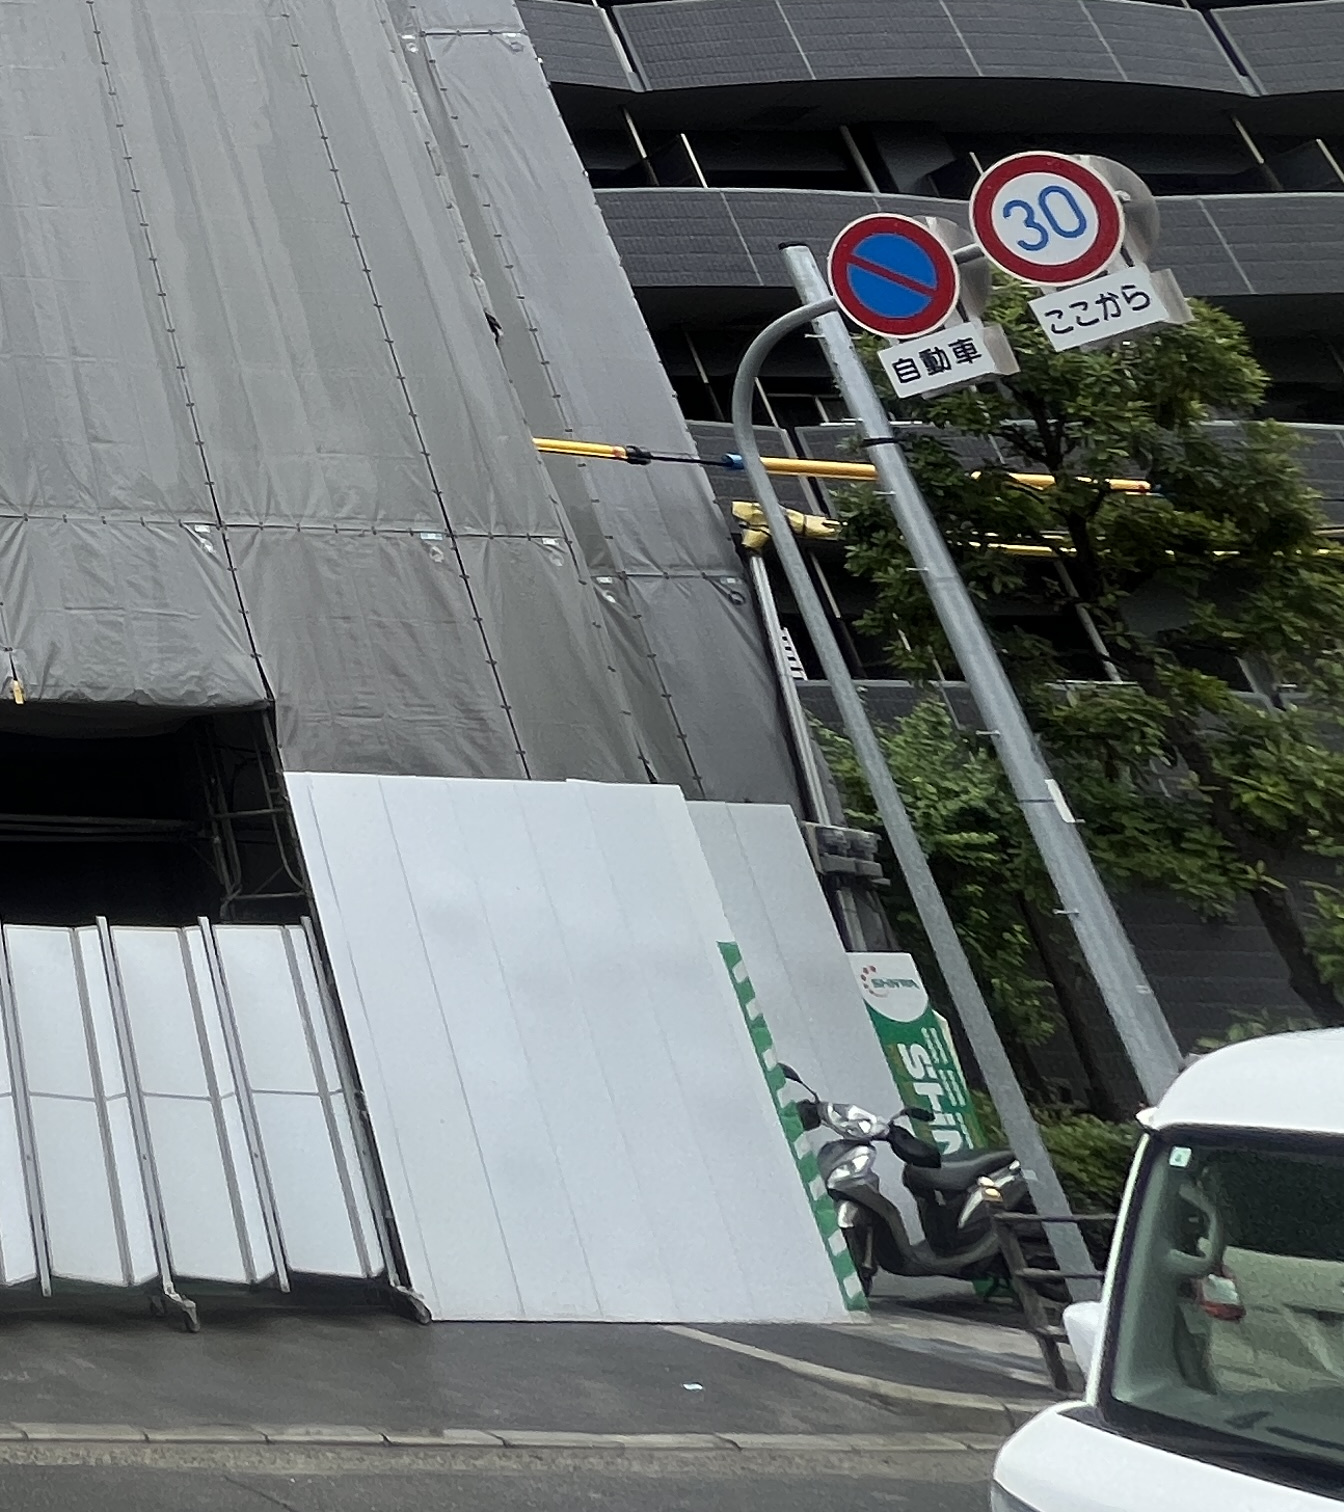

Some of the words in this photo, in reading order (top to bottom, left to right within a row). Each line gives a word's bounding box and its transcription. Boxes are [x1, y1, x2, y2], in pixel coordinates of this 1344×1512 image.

[1002, 184, 1088, 252] 30
[1043, 284, 1152, 336] ここから
[891, 335, 983, 386] 自動車
